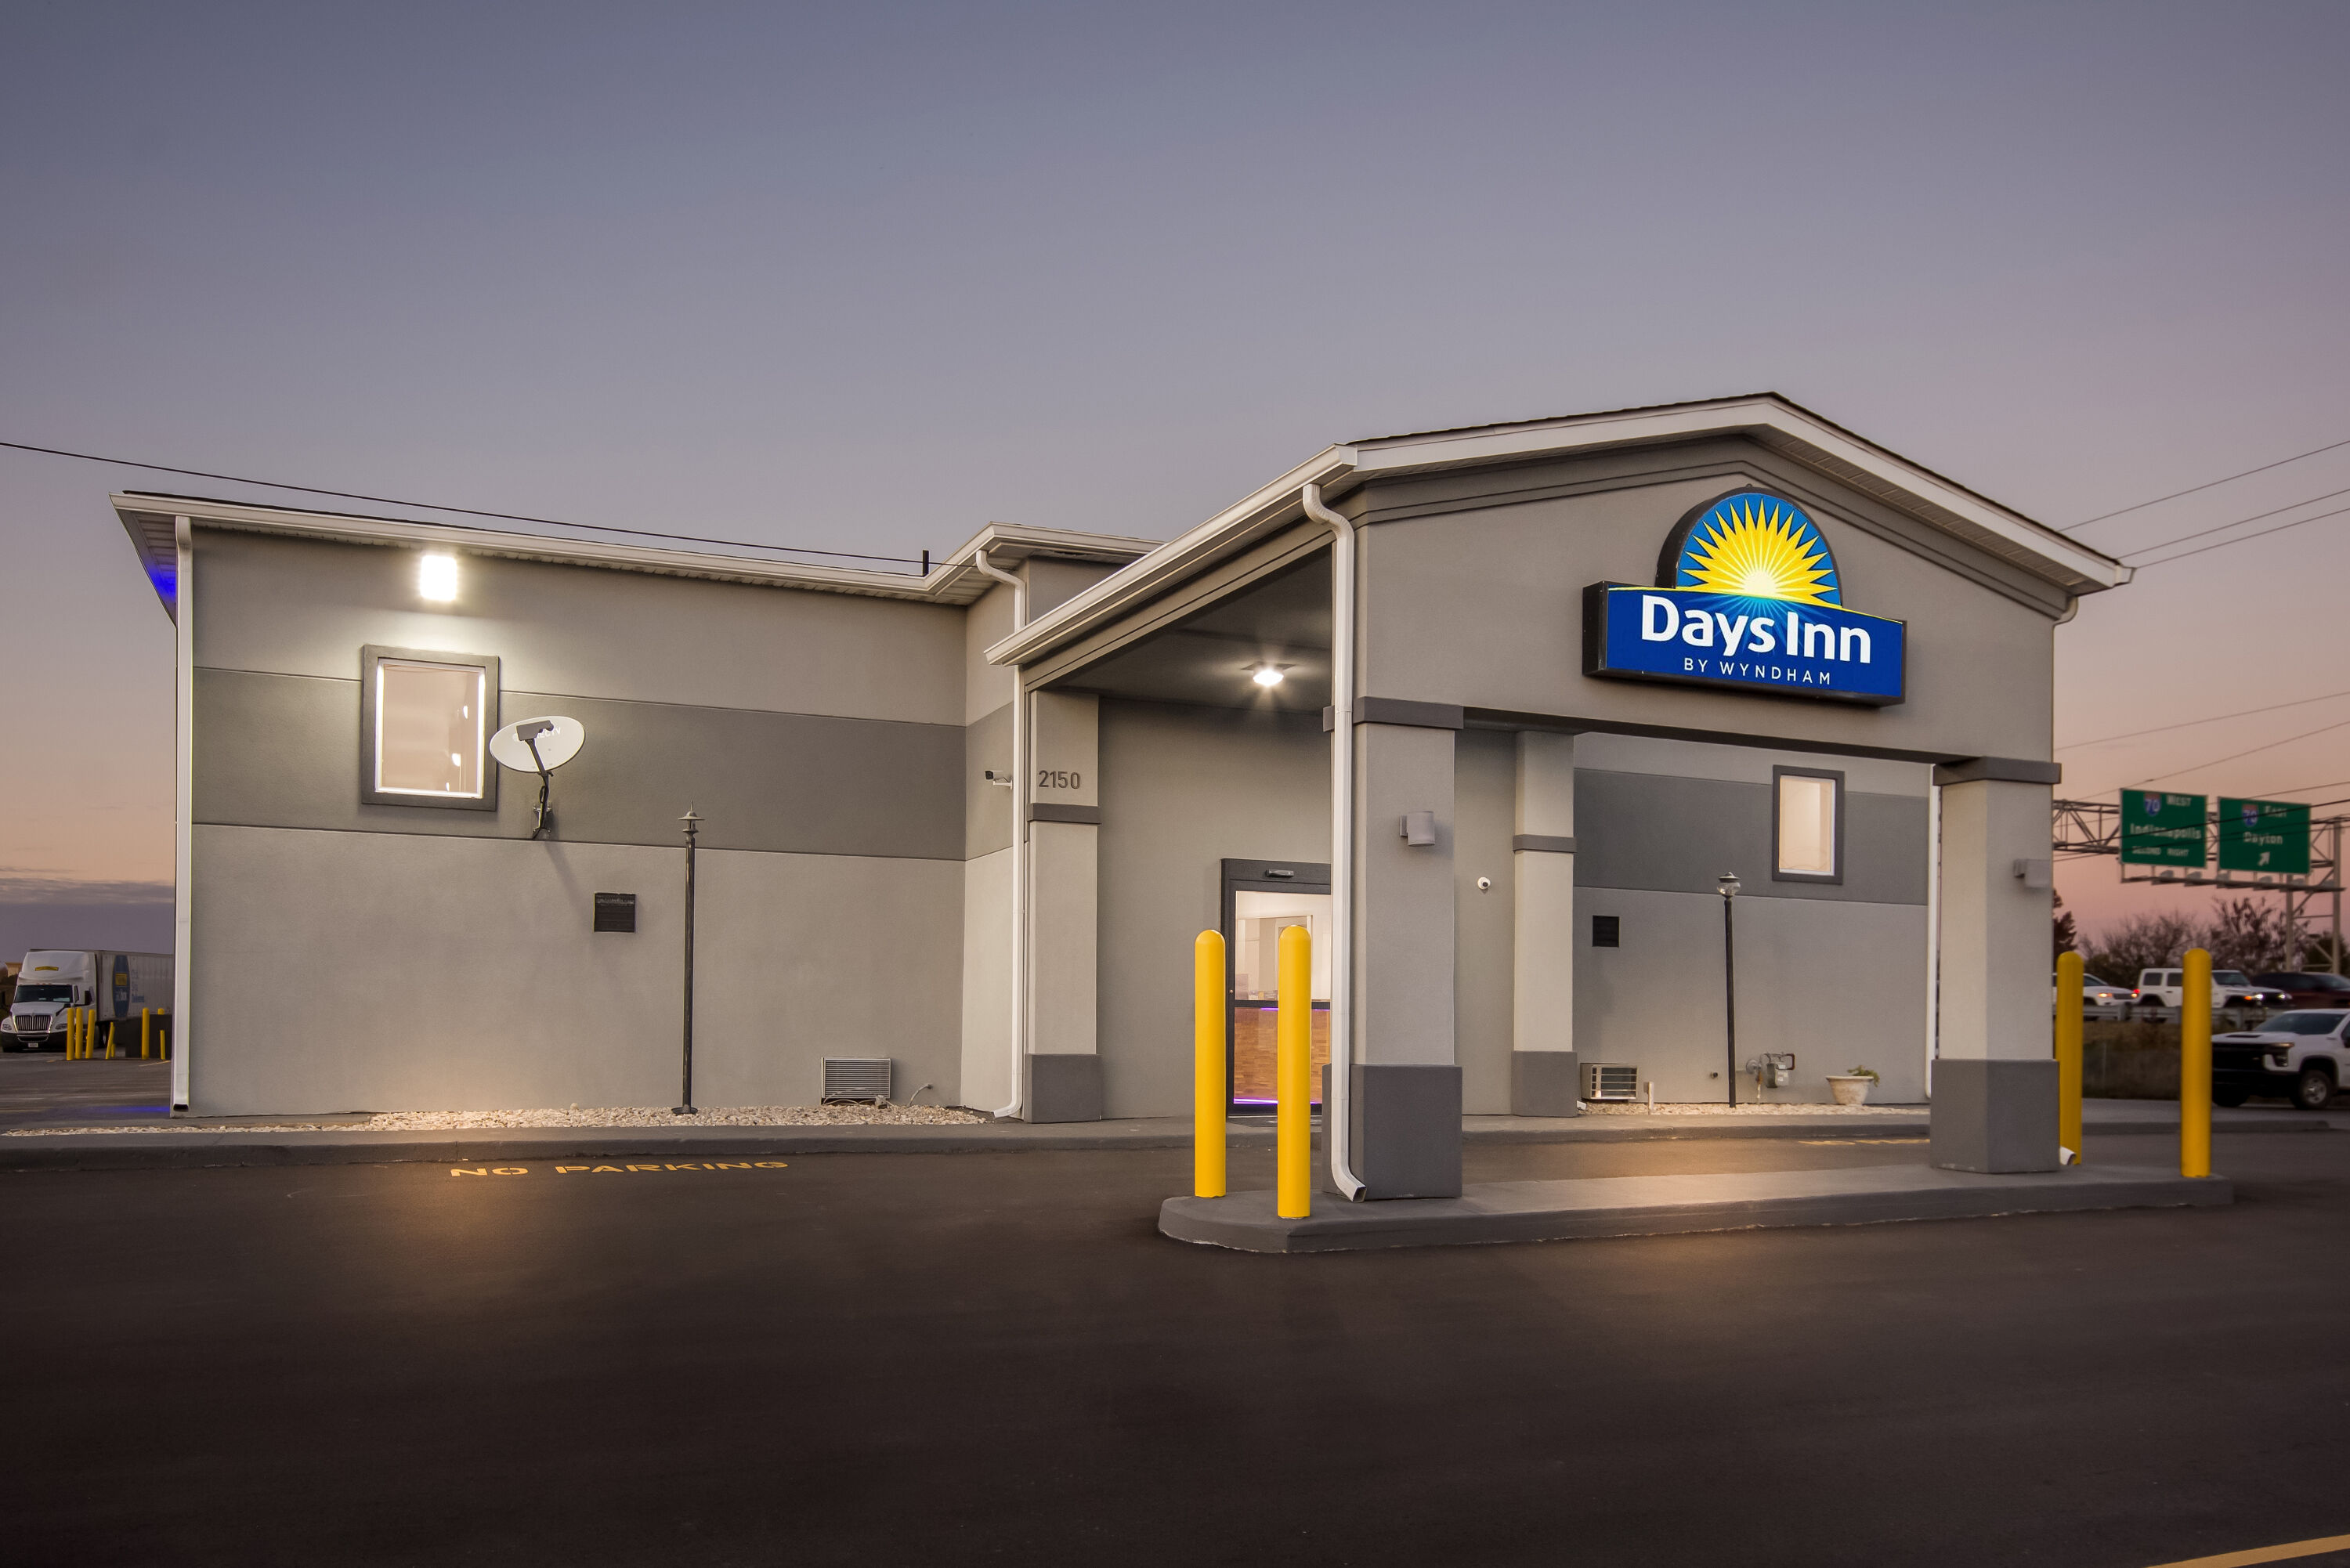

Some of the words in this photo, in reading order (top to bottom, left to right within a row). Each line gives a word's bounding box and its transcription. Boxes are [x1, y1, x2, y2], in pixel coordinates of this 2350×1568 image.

[1641, 594, 1776, 656] Days
[1787, 611, 1871, 664] Inn
[1684, 658, 1707, 673] BY
[1720, 661, 1831, 685] WYNDHAM
[1038, 770, 1081, 789] 2150
[2145, 799, 2160, 812] 70
[2166, 794, 2192, 806] WEST
[450, 1167, 529, 1176] NO
[555, 1162, 788, 1173] PARKING
